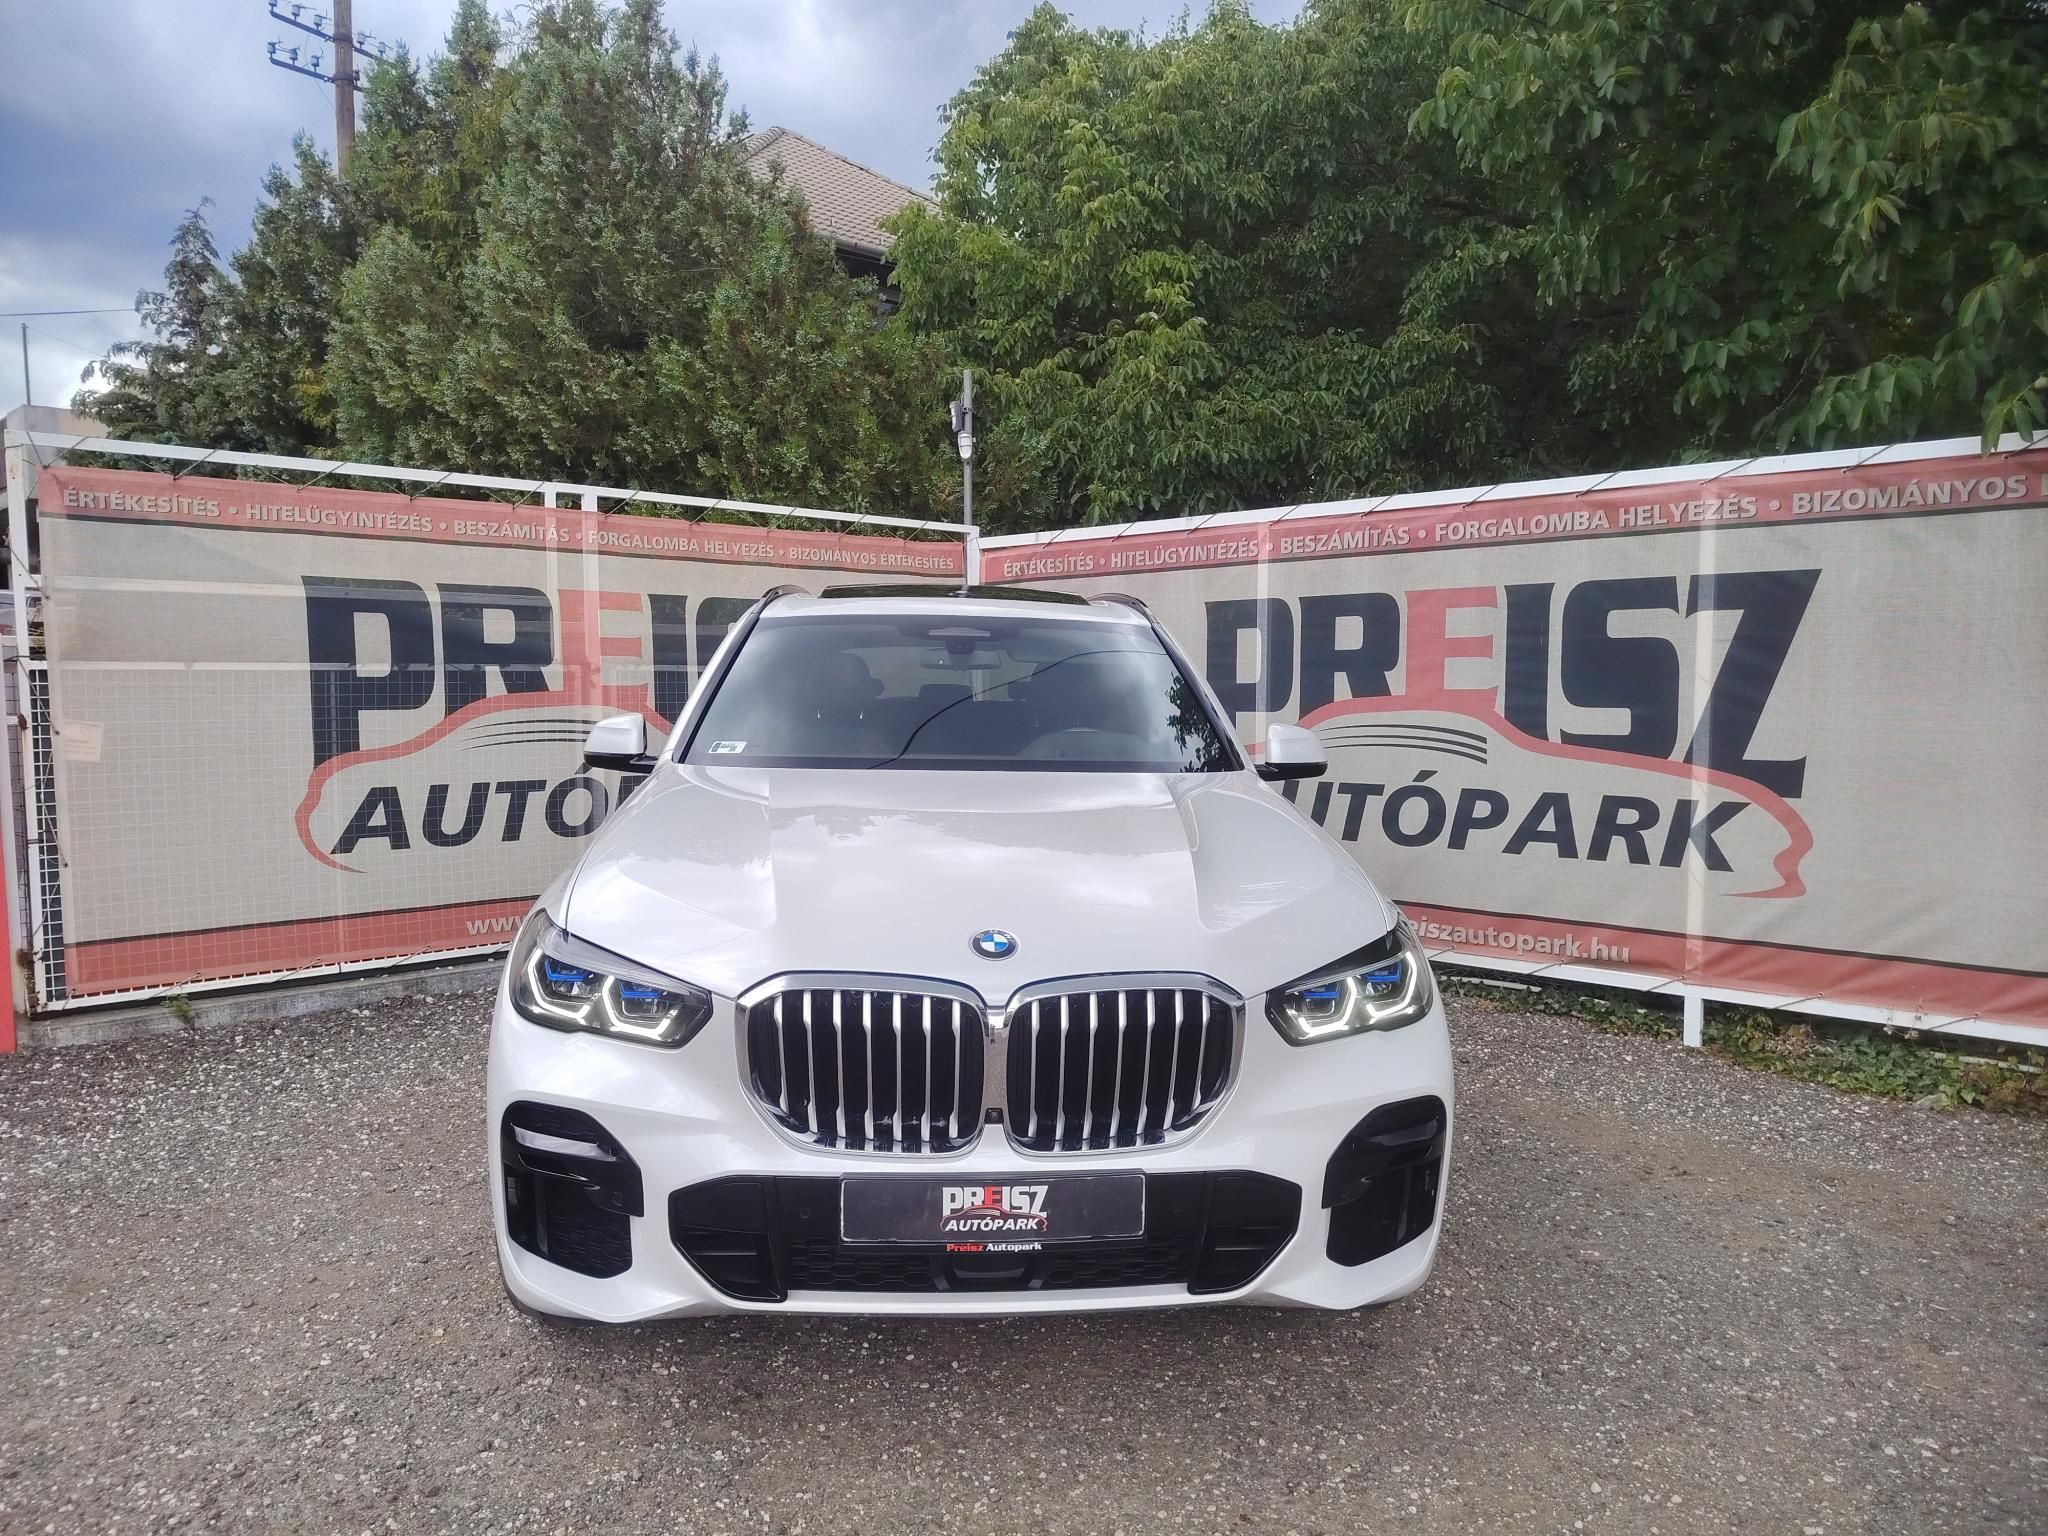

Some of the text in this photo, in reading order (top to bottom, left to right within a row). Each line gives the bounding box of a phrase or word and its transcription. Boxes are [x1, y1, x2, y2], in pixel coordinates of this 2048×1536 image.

[63, 487, 954, 570] ÉRTÉKESÍTÉS HITELÜGYINTÉZÉS BESZÁMÍTÁS FORGALOMBA HELYEZÉS BIZOMÁNYOS ÉRTÉKESÍTÉS
[1003, 554, 1095, 577] ÉRTÉKESÍTÉS
[1110, 537, 1260, 569] HITELÜGYINTÉZÉS
[1279, 525, 1411, 555] BESZÁMÍTÁS
[1434, 510, 1610, 542] FORGALOMBA
[1618, 494, 1758, 528] HELYEZÉS
[1791, 475, 2028, 514] BIZOMÁNYOS
[1204, 569, 1822, 798] PREISZ
[942, 1185, 1049, 1219] PREISZ
[944, 1217, 1041, 1232] AUTÓPARK
[946, 1242, 1042, 1253] Preisz Autopark
